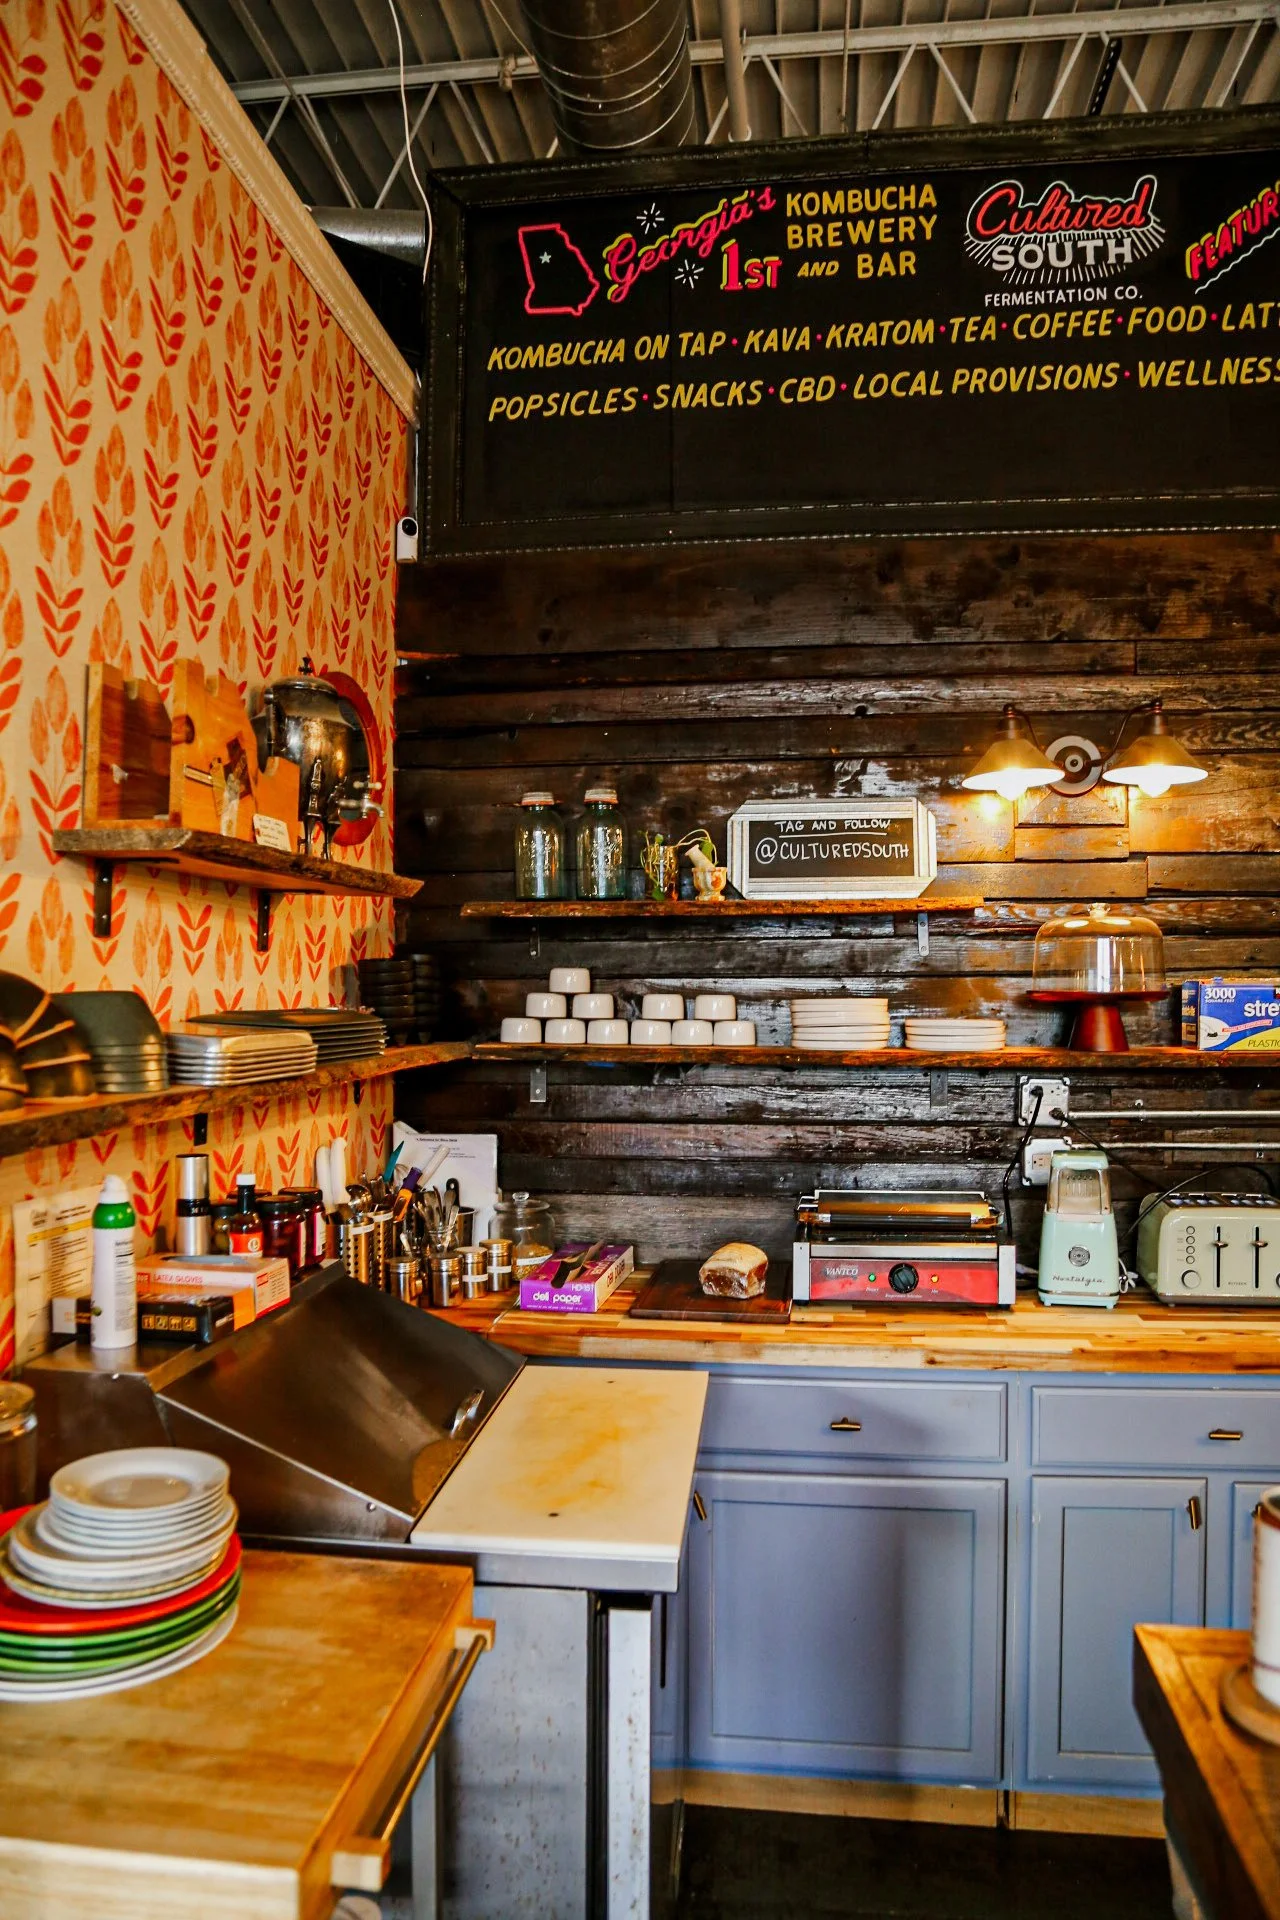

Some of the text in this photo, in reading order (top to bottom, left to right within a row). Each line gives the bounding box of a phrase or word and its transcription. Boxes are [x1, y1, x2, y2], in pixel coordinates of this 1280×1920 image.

[786, 183, 938, 217] KOMBUCHA
[975, 181, 1151, 236] Cultured
[603, 186, 776, 302] Georgia's
[787, 214, 938, 250] BREWERY
[1186, 181, 1280, 280] FEATUR
[721, 239, 782, 291] 1ST
[797, 251, 917, 279] AND BAR
[991, 237, 1134, 271] SOUTH
[984, 285, 1144, 307] FERMENTATION CO.
[487, 302, 1280, 371] KOMBUCHA ON TAP KAVA KRATOM TEA COFFEE FOOD LAT
[488, 386, 639, 422] POPSICLES
[652, 379, 764, 411] SNACKS
[779, 374, 836, 405] CBD
[853, 370, 943, 400] LOCAL
[951, 362, 1121, 395] PROVISIONS
[774, 818, 891, 833] TAG AND FOLLOW
[755, 837, 910, 865] @CULTUREDSOUTH
[1204, 987, 1237, 999] 3000
[1243, 1000, 1280, 1018] stre
[175, 1275, 204, 1283] GLOVES
[552, 1293, 582, 1305] paper
